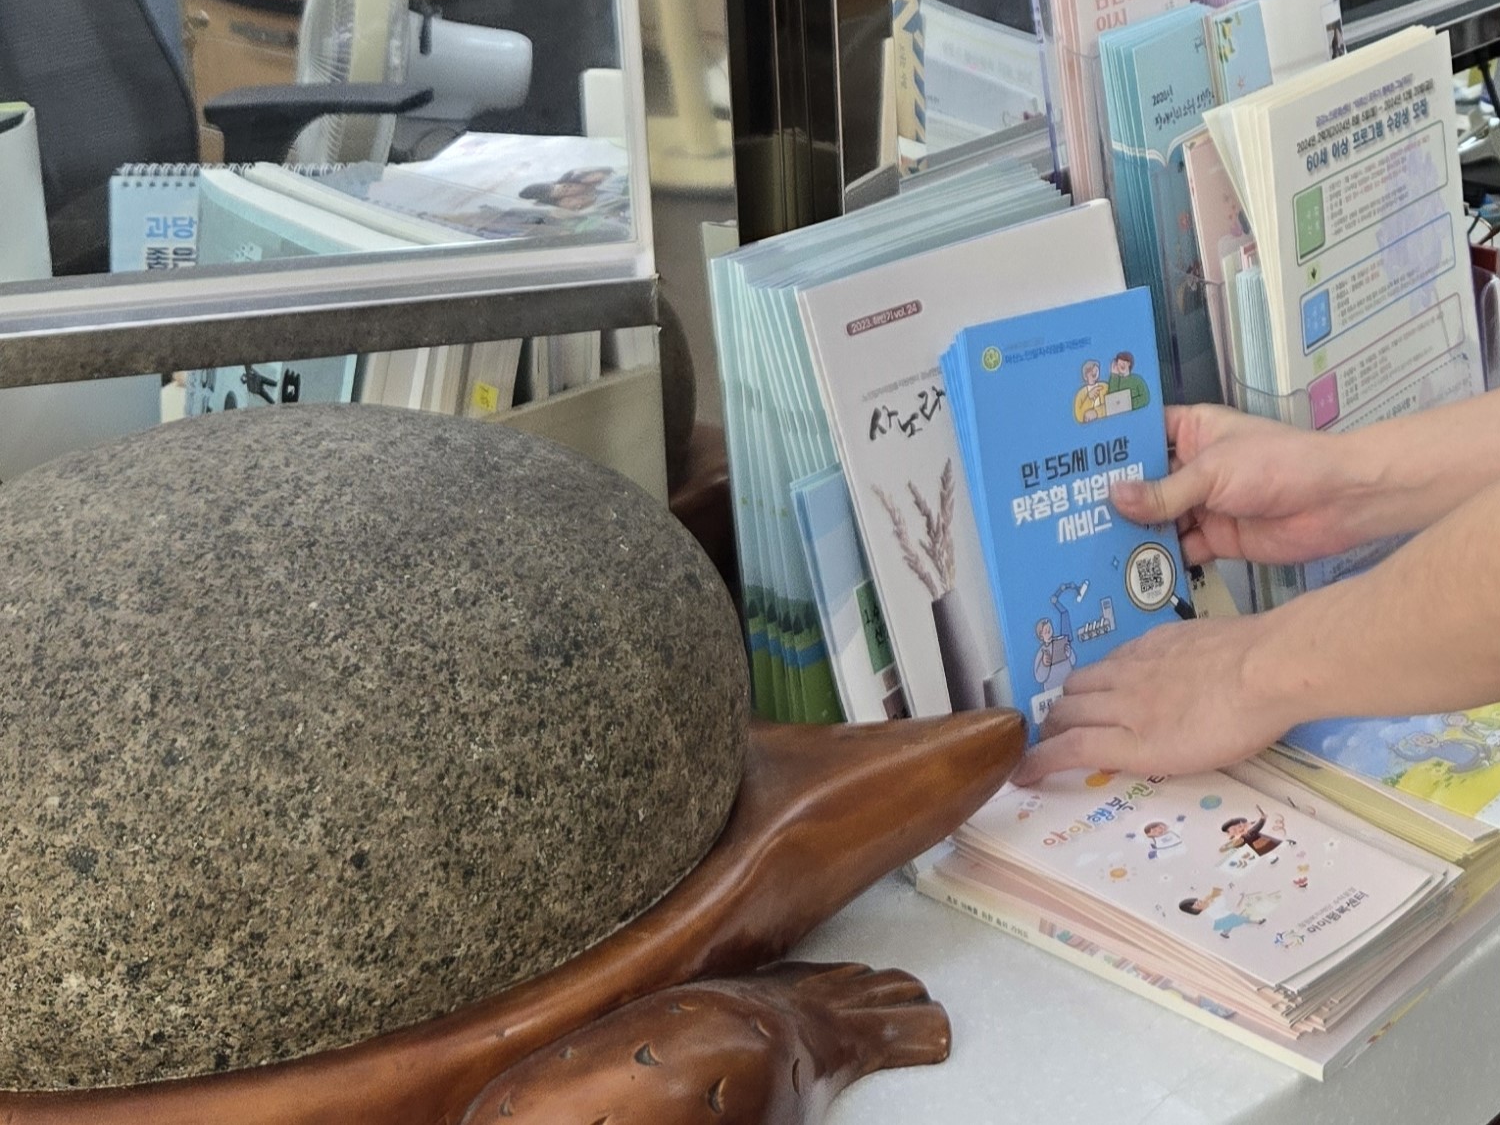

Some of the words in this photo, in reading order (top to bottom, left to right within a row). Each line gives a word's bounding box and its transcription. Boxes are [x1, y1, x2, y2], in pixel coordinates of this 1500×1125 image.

[1306, 147, 1328, 172] 60세
[1331, 137, 1349, 158] 이상
[1352, 120, 1384, 150] 프로그램
[1386, 106, 1410, 131] 수강생
[1021, 460, 1040, 489] 만
[1045, 446, 1089, 481] 55세
[1094, 435, 1130, 467] 이상
[1012, 483, 1070, 526] 맞춤형
[1057, 505, 1113, 544] 서비스
